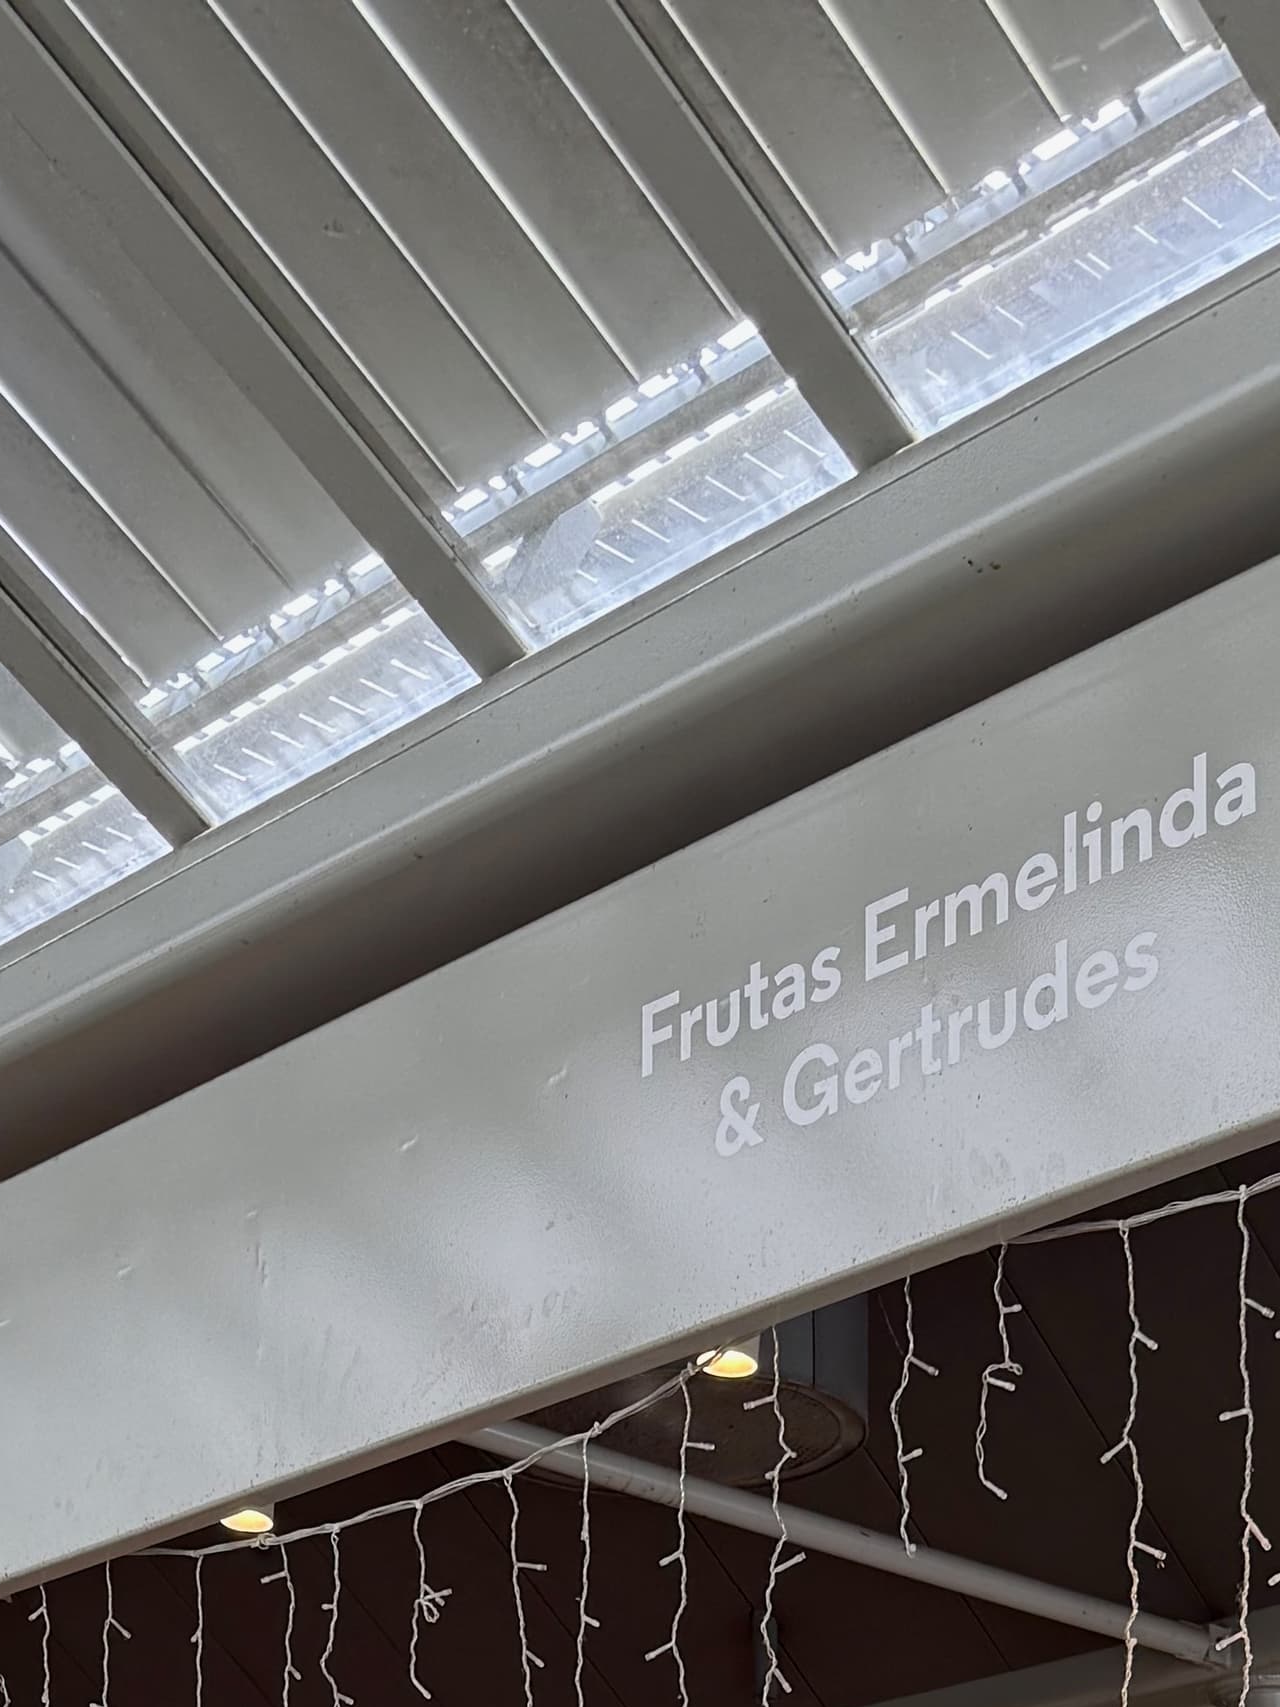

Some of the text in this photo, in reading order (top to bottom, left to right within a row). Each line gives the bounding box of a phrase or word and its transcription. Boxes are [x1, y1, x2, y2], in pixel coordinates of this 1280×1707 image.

[641, 751, 1257, 1078] Frutas Ermelinda
[715, 931, 1159, 1157] & Gertrudes
